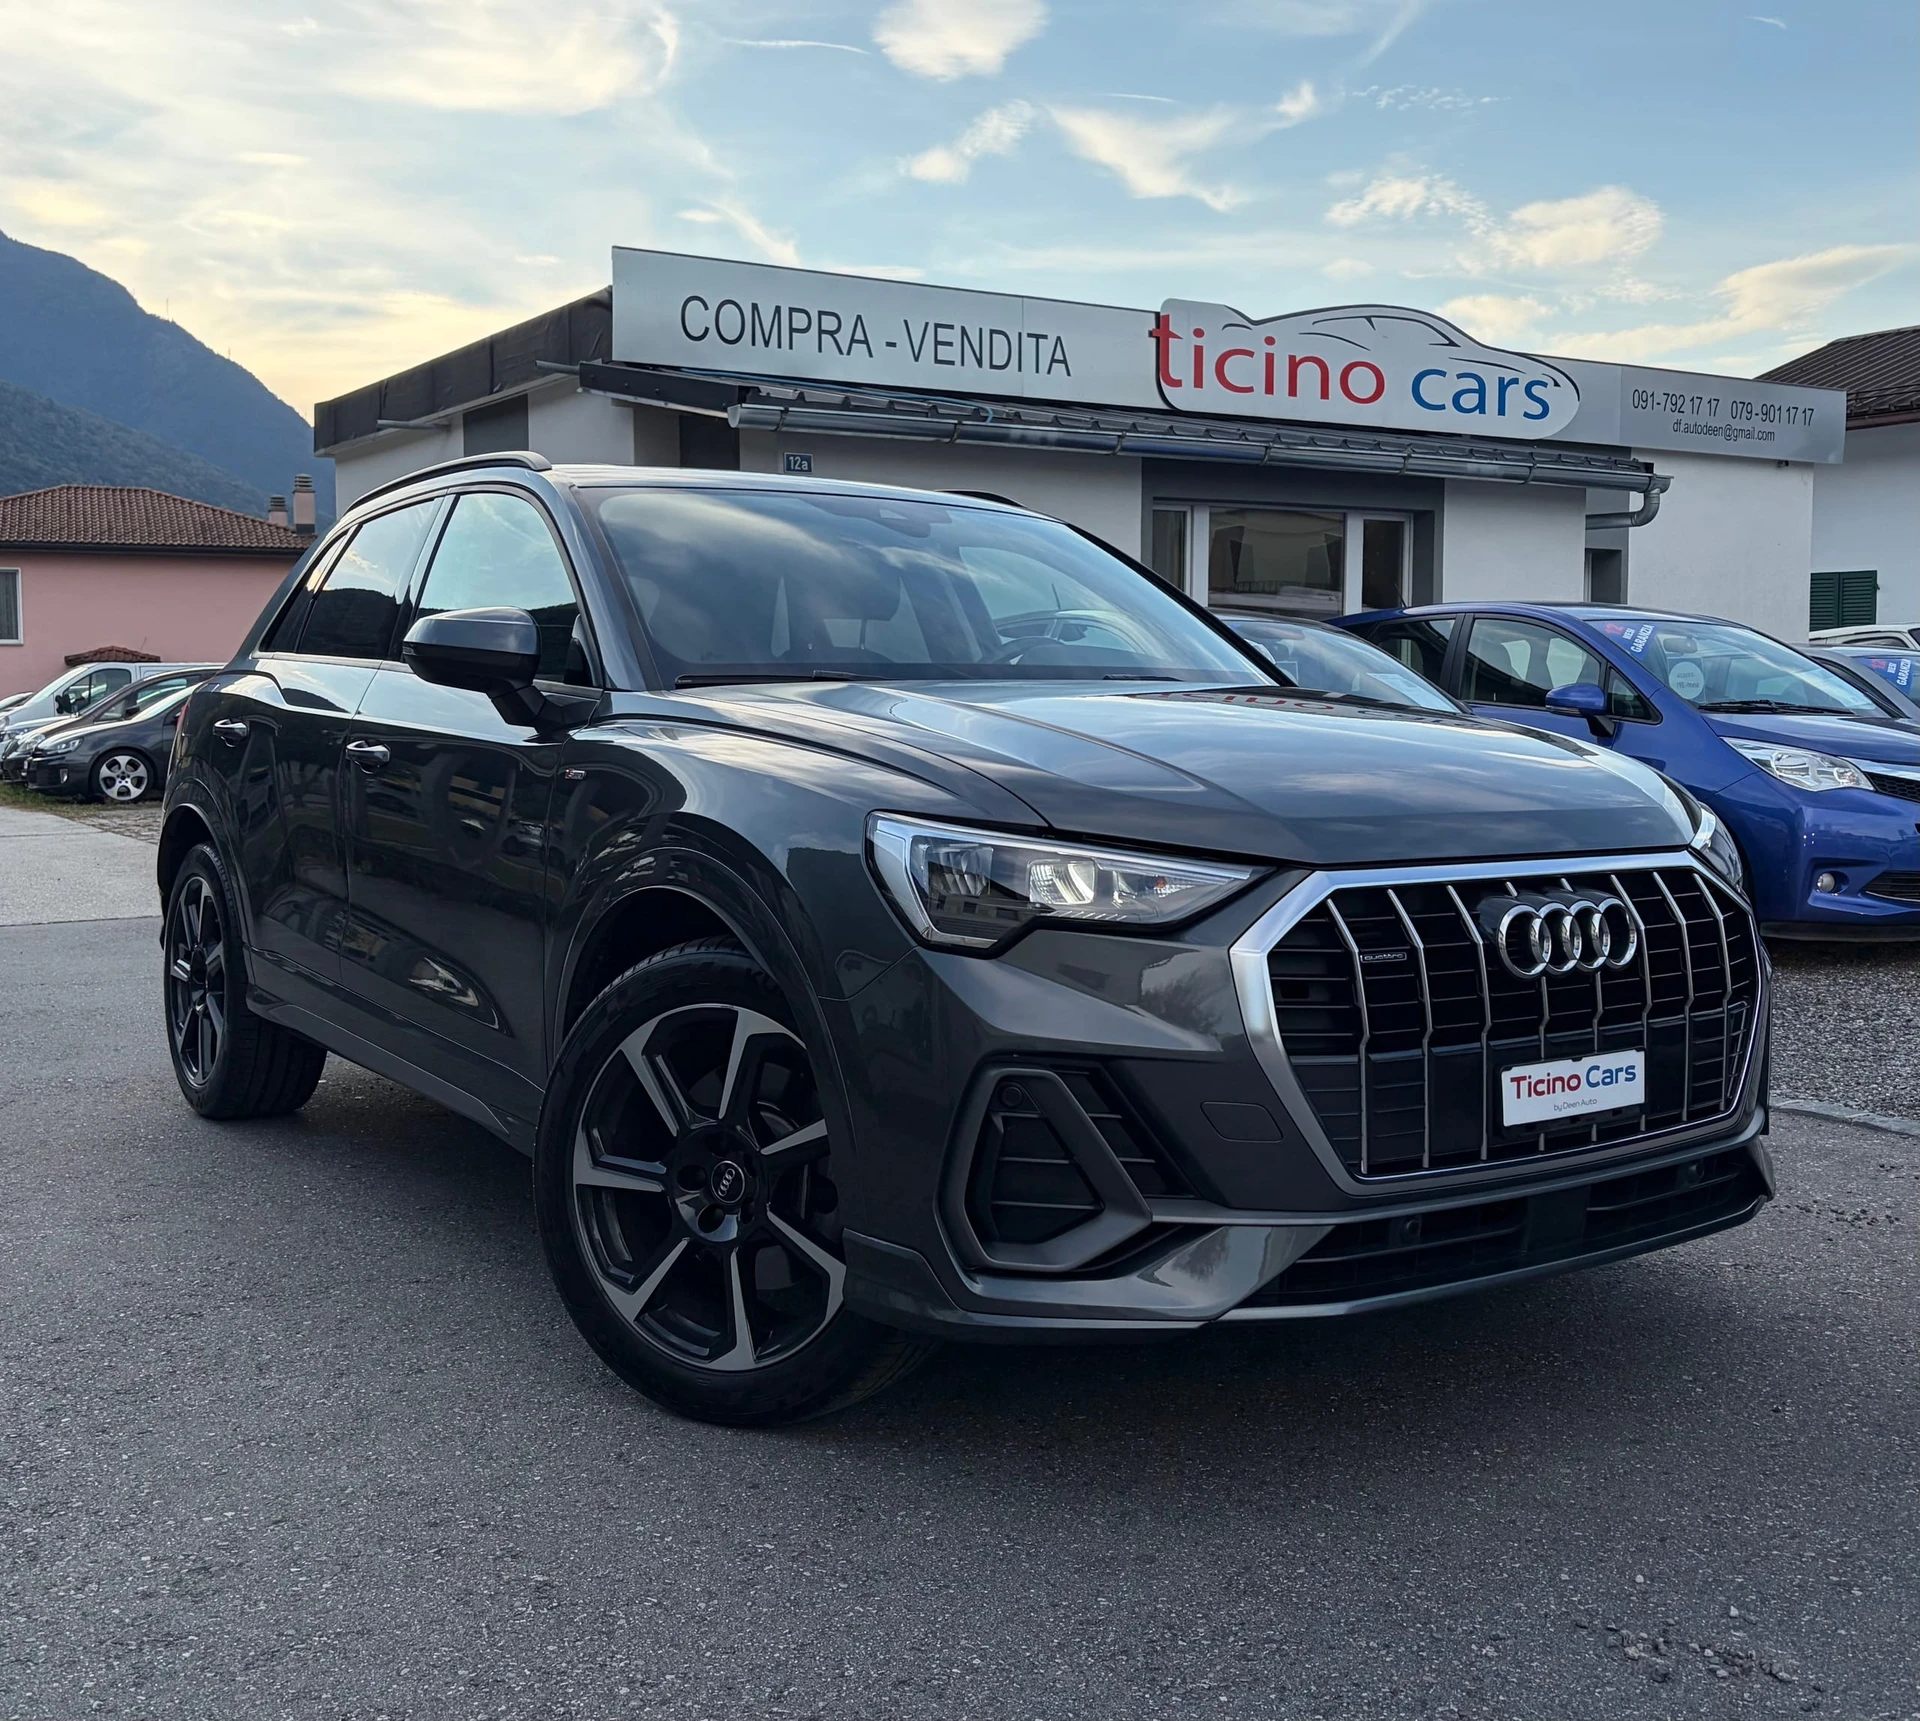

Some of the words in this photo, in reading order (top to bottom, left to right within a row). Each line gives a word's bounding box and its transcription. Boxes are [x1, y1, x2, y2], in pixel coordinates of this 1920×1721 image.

[681, 295, 874, 358] COMPRA
[1148, 314, 1386, 404] ticino
[1411, 368, 1551, 420] cars
[1632, 389, 1686, 414] 091-792
[1707, 398, 1720, 417] 17
[1672, 418, 1775, 442] df.autodeen@gmail.com
[789, 456, 809, 470] 12a
[1630, 624, 1655, 653] GARANZIA
[1364, 953, 1404, 961] quattro
[1510, 1072, 1582, 1099] Ticino
[1586, 1065, 1637, 1088] Cars
[1553, 1104, 1563, 1112] by
[1563, 1101, 1580, 1110] Deen
